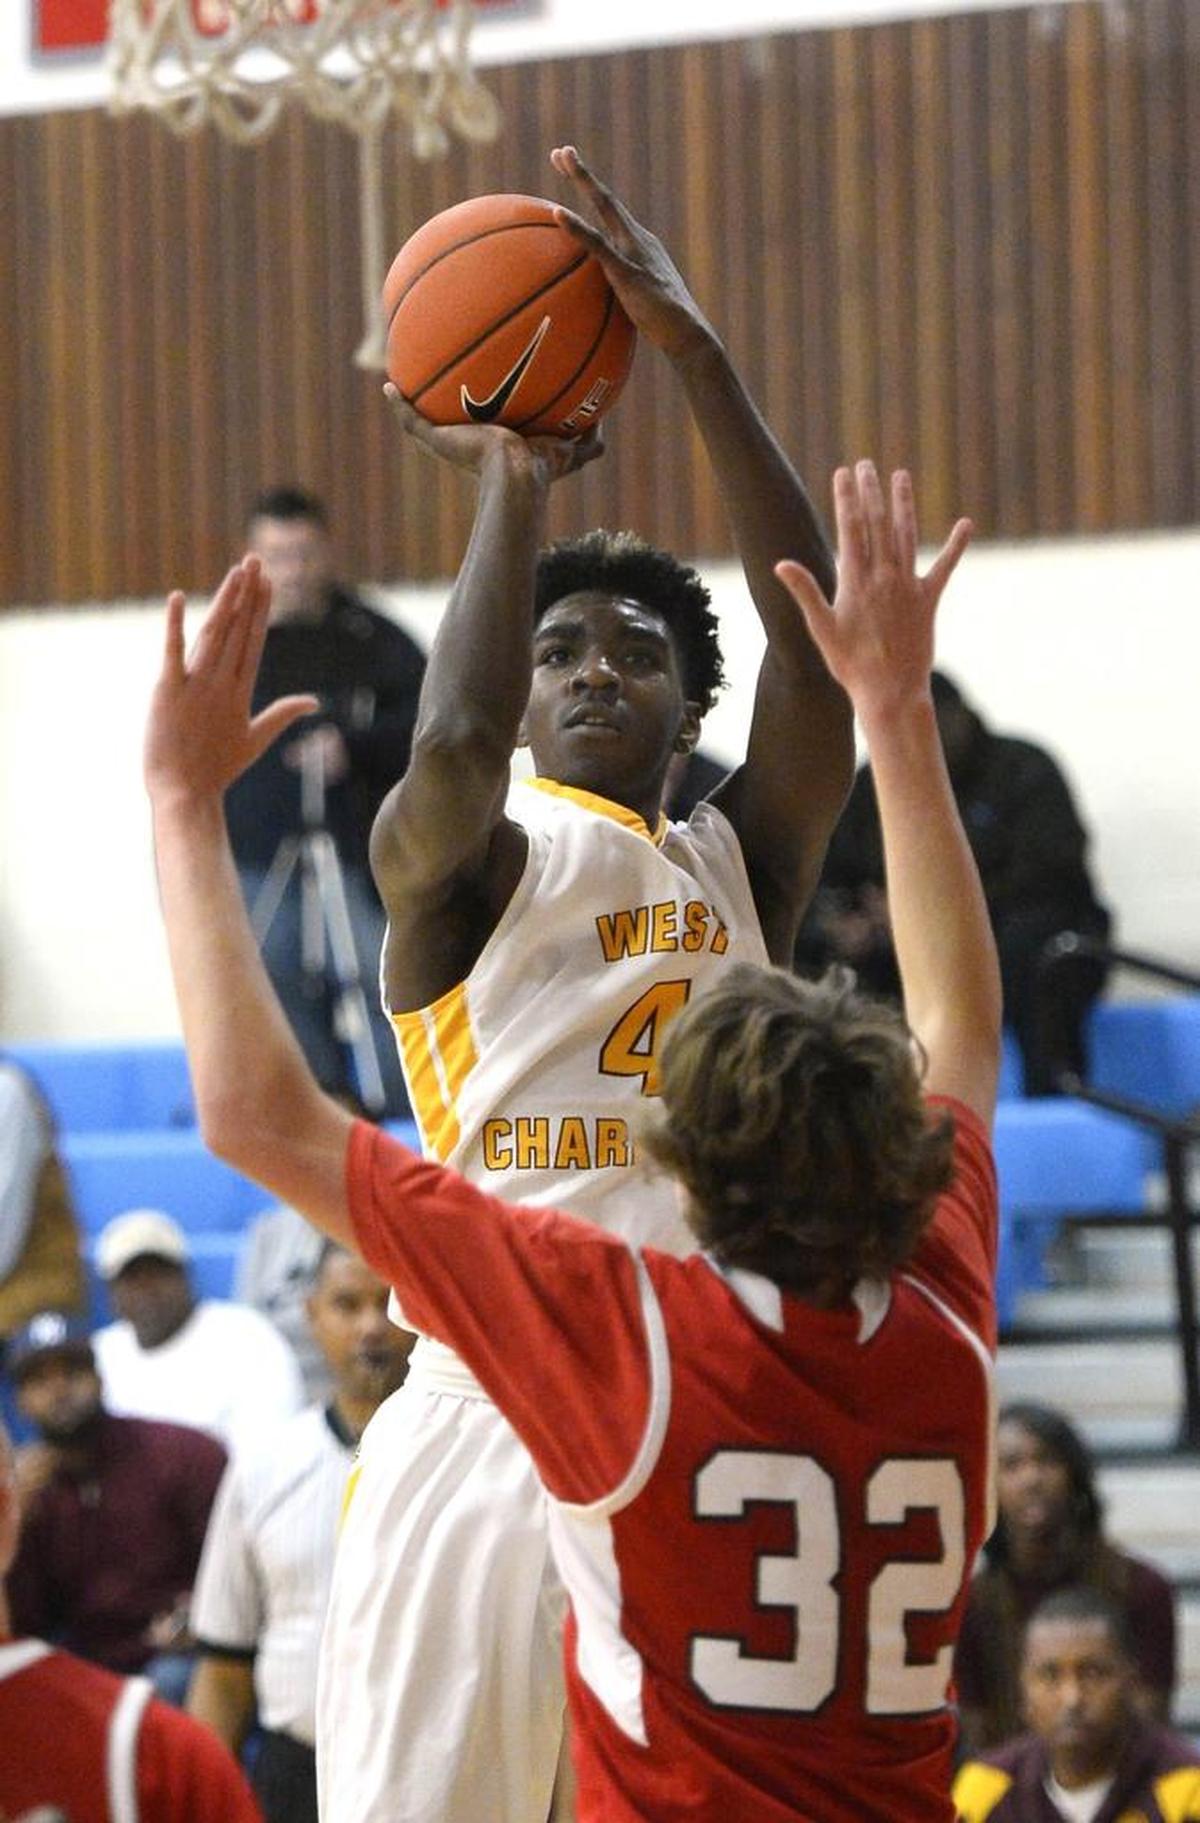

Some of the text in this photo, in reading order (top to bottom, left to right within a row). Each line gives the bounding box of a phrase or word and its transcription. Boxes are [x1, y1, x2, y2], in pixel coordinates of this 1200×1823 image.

[599, 979, 691, 1097] 4
[482, 1117, 635, 1170] CHAR
[690, 1446, 965, 1716] 32
